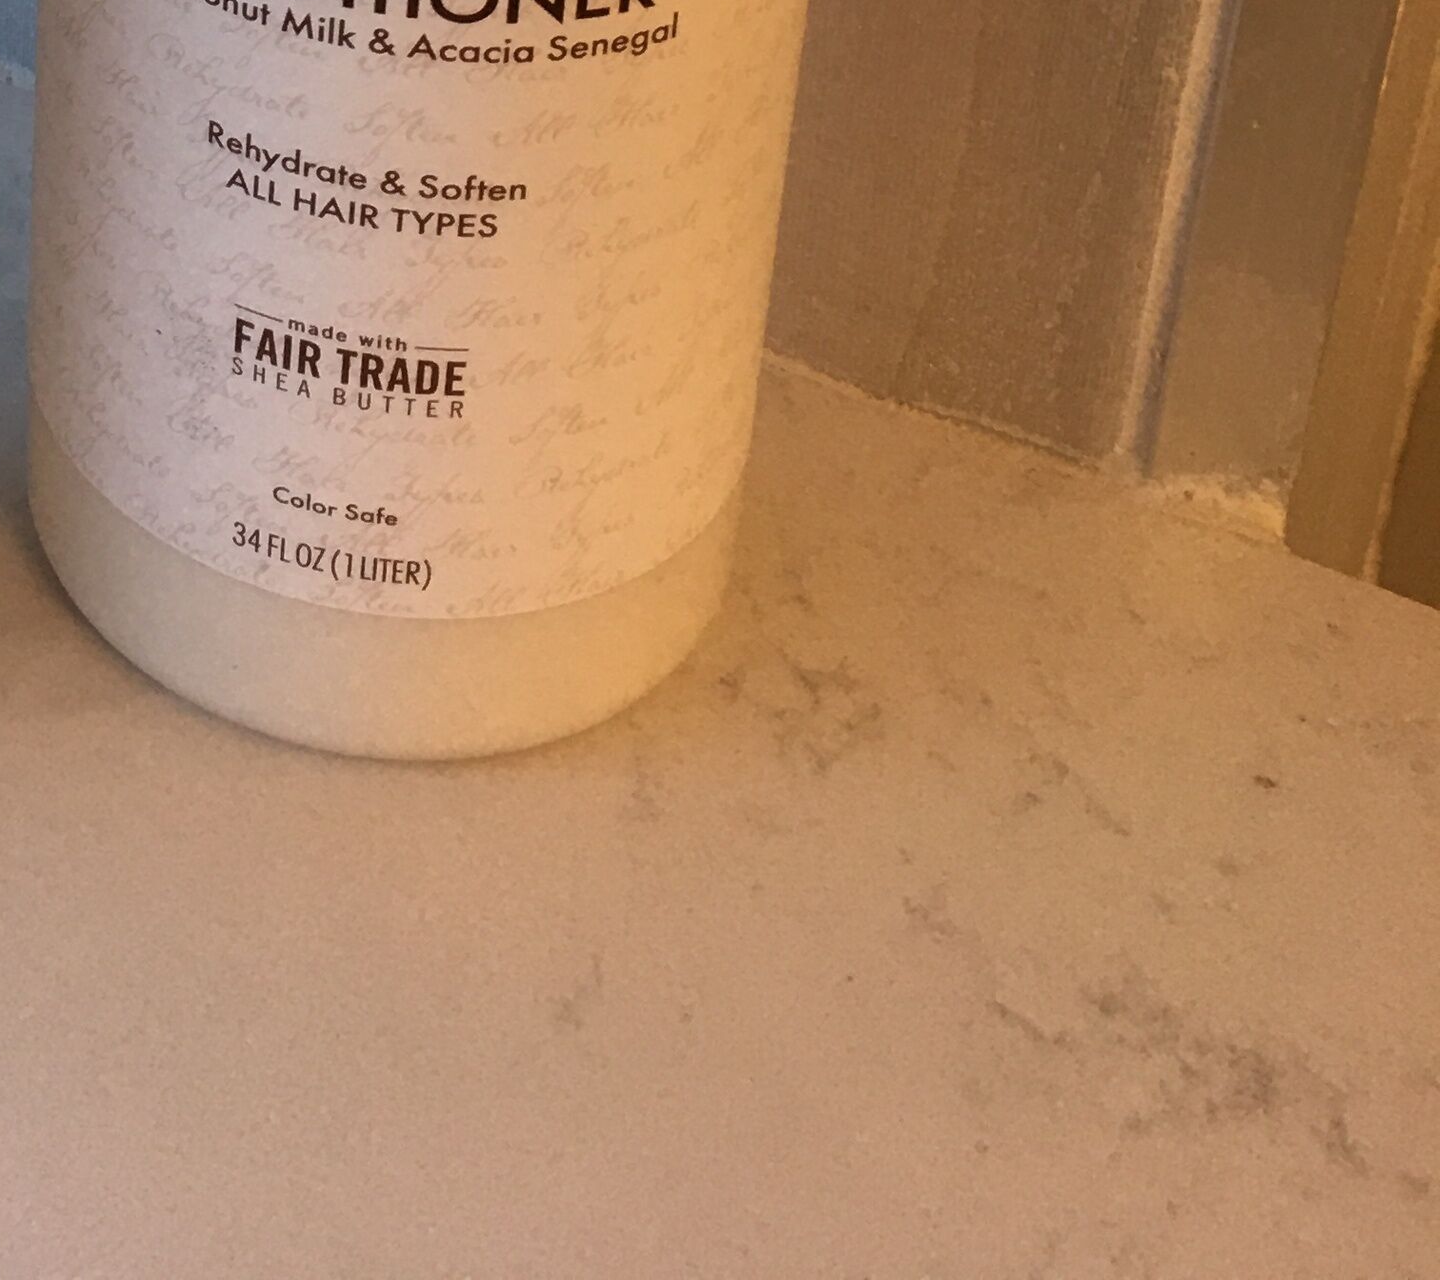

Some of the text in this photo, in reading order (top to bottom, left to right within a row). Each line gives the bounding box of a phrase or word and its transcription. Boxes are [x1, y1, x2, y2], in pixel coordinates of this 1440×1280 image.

[281, 7, 355, 50] Milk
[369, 28, 395, 54] &
[408, 33, 535, 64] Acacia
[548, 11, 678, 60] Senegal
[208, 120, 367, 191] Rehydrate
[380, 170, 405, 196] &
[418, 172, 528, 202] Soften
[225, 166, 498, 238] ALL HAIR TYPES
[234, 318, 468, 396] FAIR TRADE
[288, 318, 408, 351] made with
[231, 357, 464, 419] SHEA BUTTER
[272, 486, 398, 526] Color Safe
